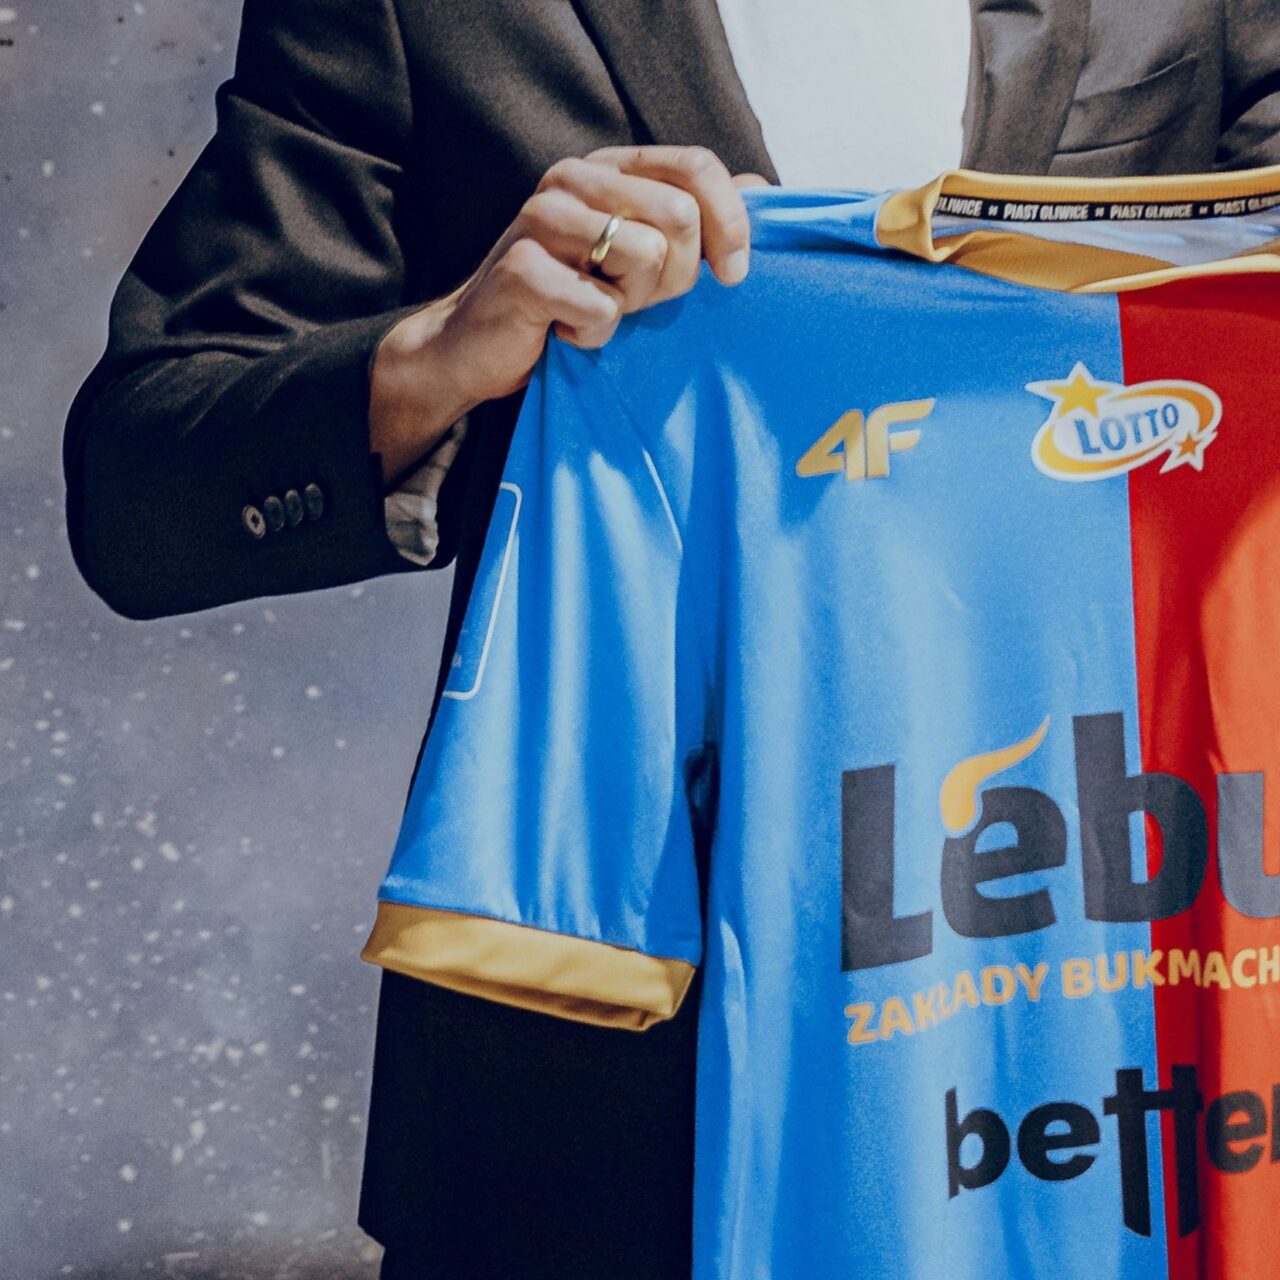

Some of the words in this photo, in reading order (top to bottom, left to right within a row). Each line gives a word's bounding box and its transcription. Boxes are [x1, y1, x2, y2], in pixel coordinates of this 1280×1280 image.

[1004, 203, 1039, 220] PIAST
[1040, 204, 1089, 220] GLIWICE
[1110, 204, 1144, 219] PIAST
[1145, 204, 1193, 218] GLIWICE
[1213, 199, 1246, 216] PIAST
[796, 398, 936, 483] 4F
[1074, 403, 1180, 455] LOTTO
[844, 962, 1049, 1044] ZAKŁADY
